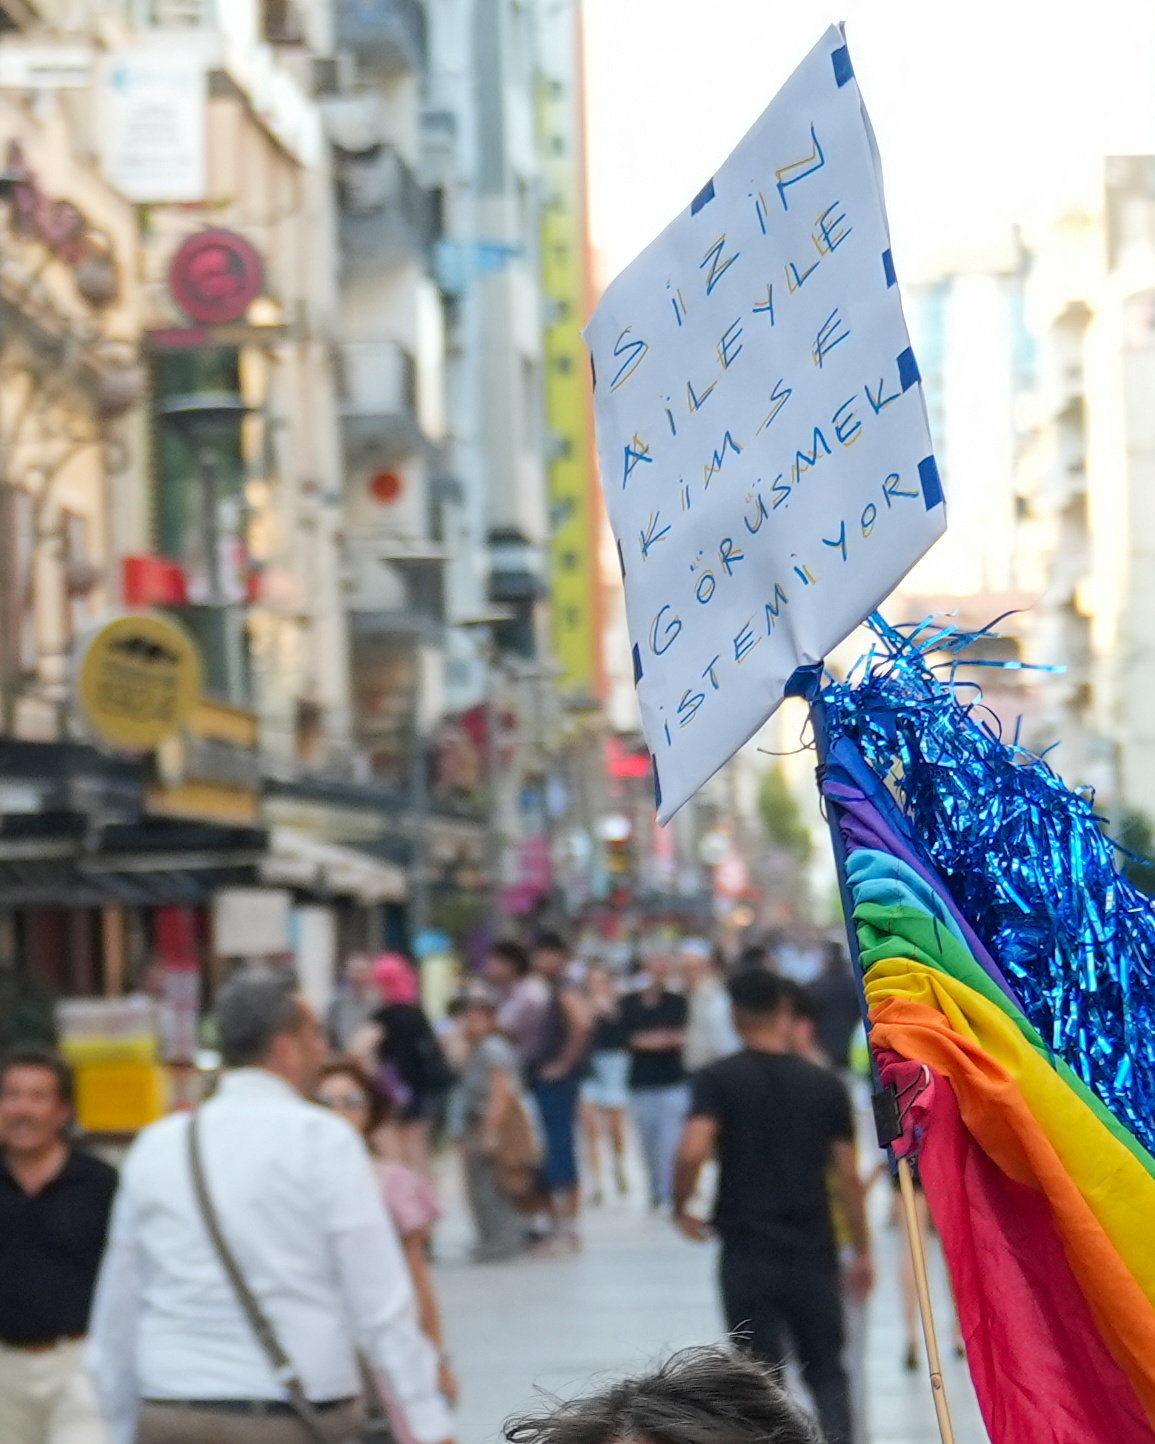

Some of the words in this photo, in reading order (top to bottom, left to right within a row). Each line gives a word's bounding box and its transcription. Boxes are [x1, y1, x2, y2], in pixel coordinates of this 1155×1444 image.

[610, 121, 825, 394] SİZİN
[622, 200, 854, 490] AİLEYLE
[639, 307, 851, 561] KİMSE
